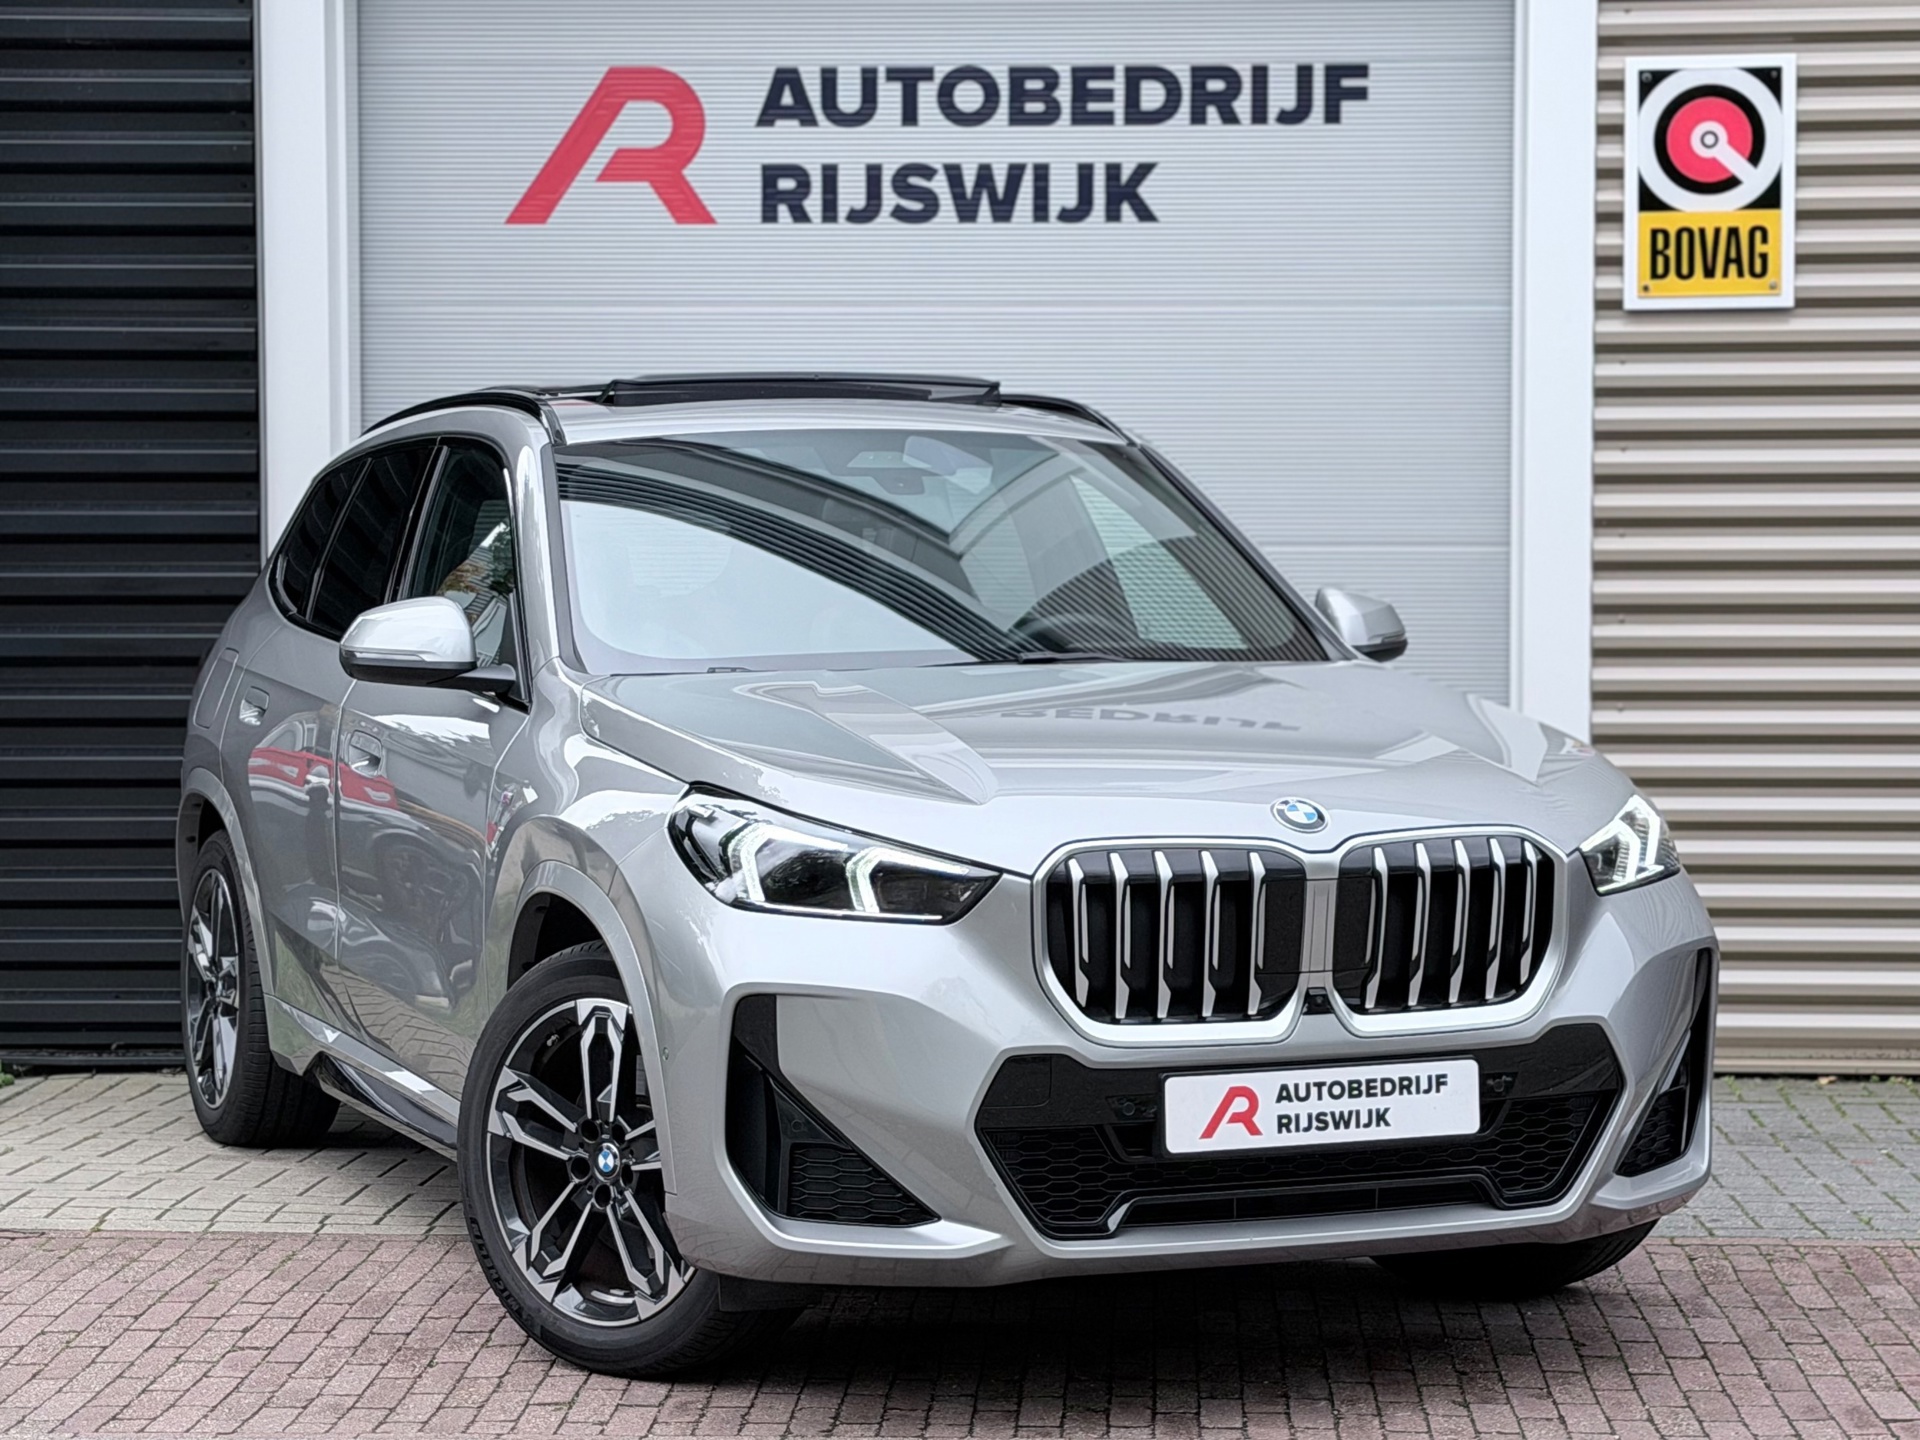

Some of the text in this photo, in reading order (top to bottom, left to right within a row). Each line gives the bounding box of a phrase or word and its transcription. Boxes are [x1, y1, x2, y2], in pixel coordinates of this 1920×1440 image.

[756, 64, 1369, 127] AUTOBEDRIJF
[762, 162, 1158, 224] RIJSWIJK
[1650, 225, 1769, 281] BOVAG
[1275, 1074, 1448, 1104] AUTOBEDRIJF
[1277, 1107, 1391, 1134] RIJSWIJK
[470, 1219, 520, 1312] MICHELIN
